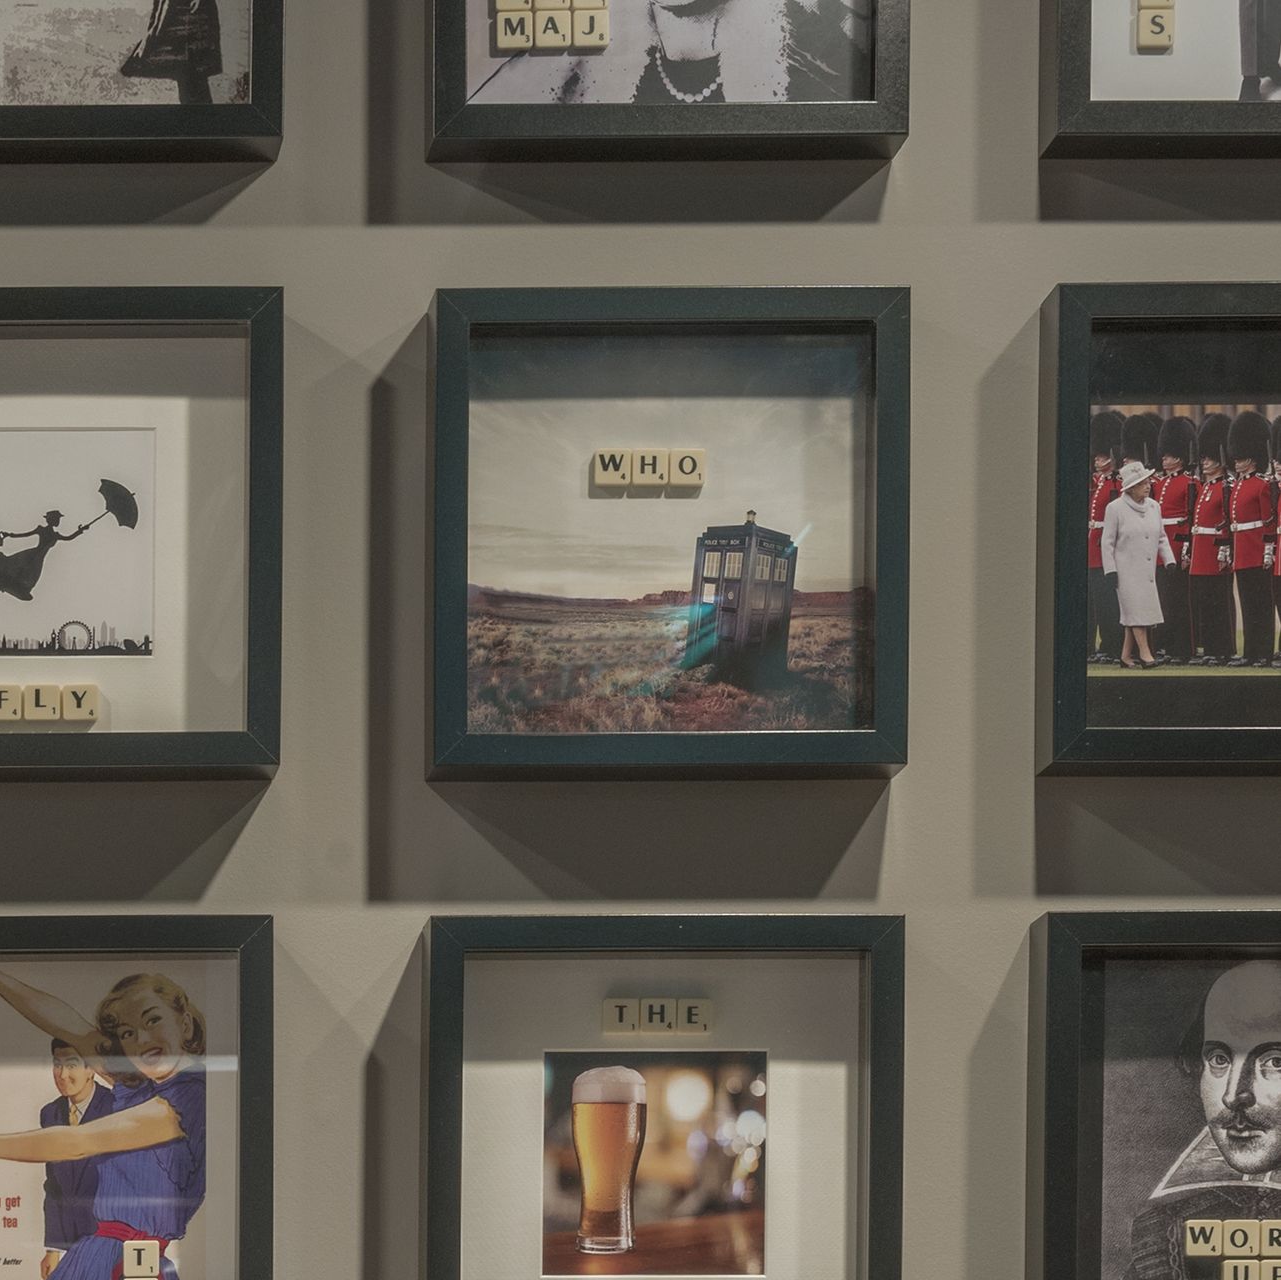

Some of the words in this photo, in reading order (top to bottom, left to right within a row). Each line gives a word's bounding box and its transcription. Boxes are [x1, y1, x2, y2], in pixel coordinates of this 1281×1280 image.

[598, 453, 702, 481] WHO
[614, 1003, 707, 1031] THE
[6, 1195, 21, 1211] get
[3, 1216, 18, 1228] tea
